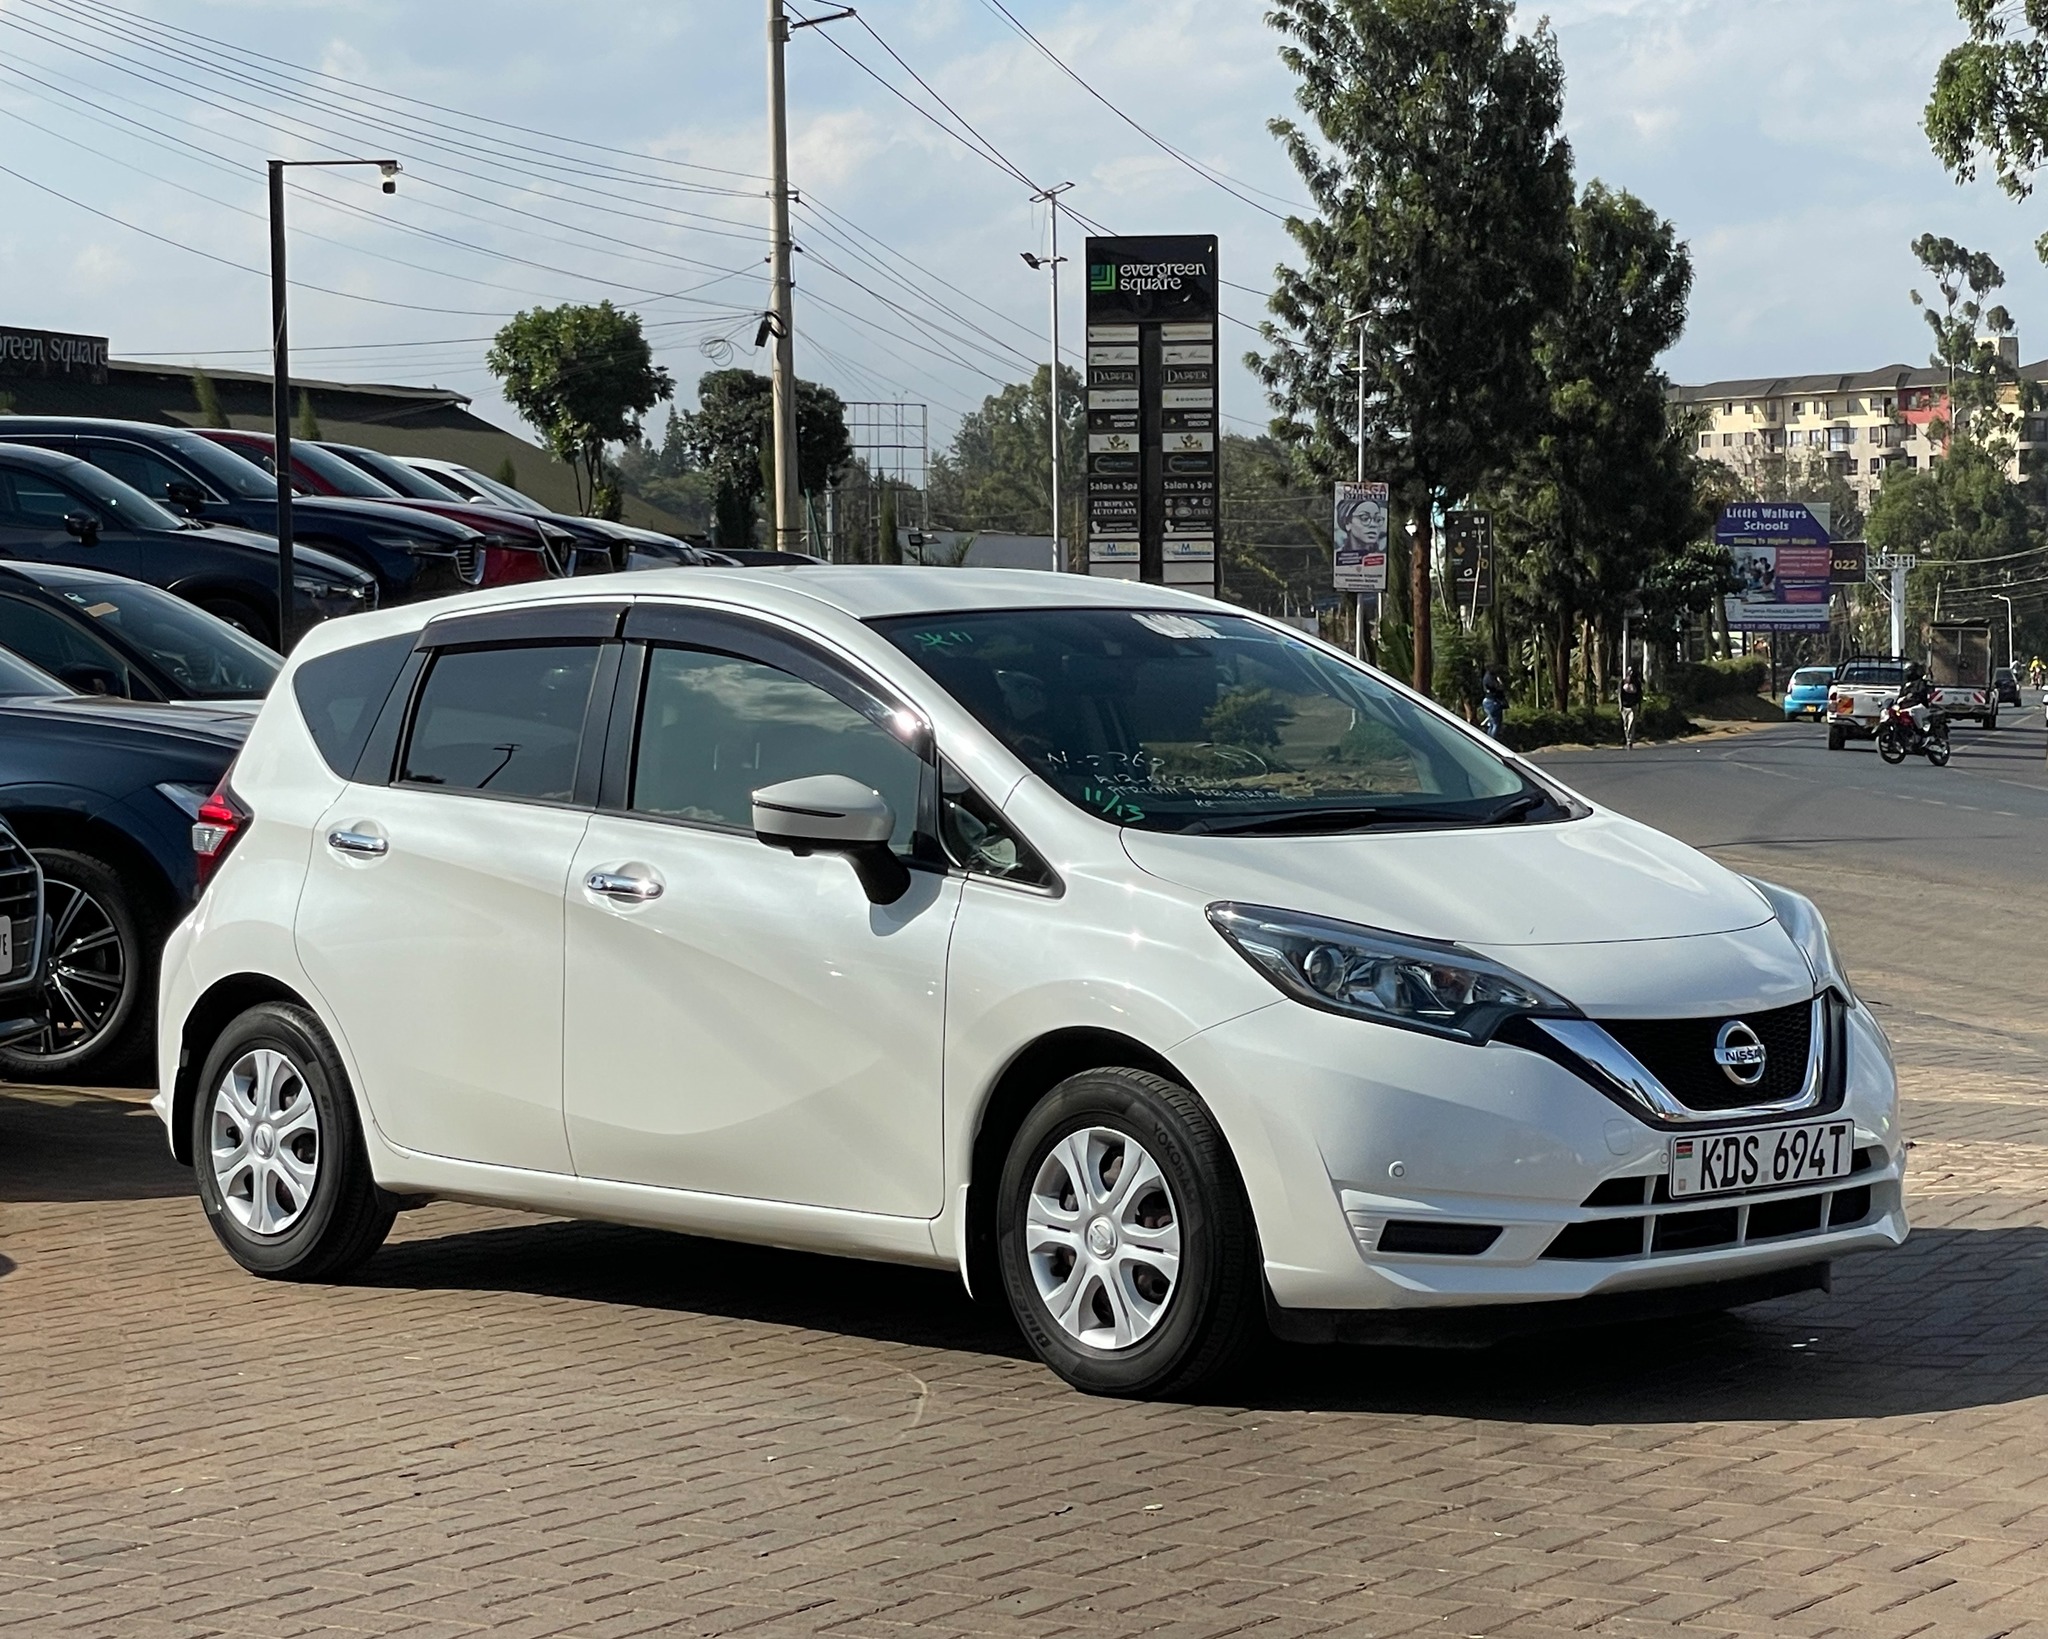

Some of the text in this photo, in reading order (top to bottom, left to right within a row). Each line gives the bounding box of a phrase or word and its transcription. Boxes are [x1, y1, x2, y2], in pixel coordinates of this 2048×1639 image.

[1120, 263, 1207, 280] evergreen
[1120, 276, 1182, 295] square
[50, 338, 108, 372] square
[1090, 482, 1115, 490] Salon
[1122, 482, 1138, 492] Spa
[1164, 481, 1188, 490] Salon
[1197, 481, 1212, 491] Spa
[1726, 508, 1807, 519] Little Walkers
[1744, 521, 1789, 531] Schools
[1725, 1047, 1762, 1062] NISSA
[1701, 1125, 1846, 1190] KDS 694T
